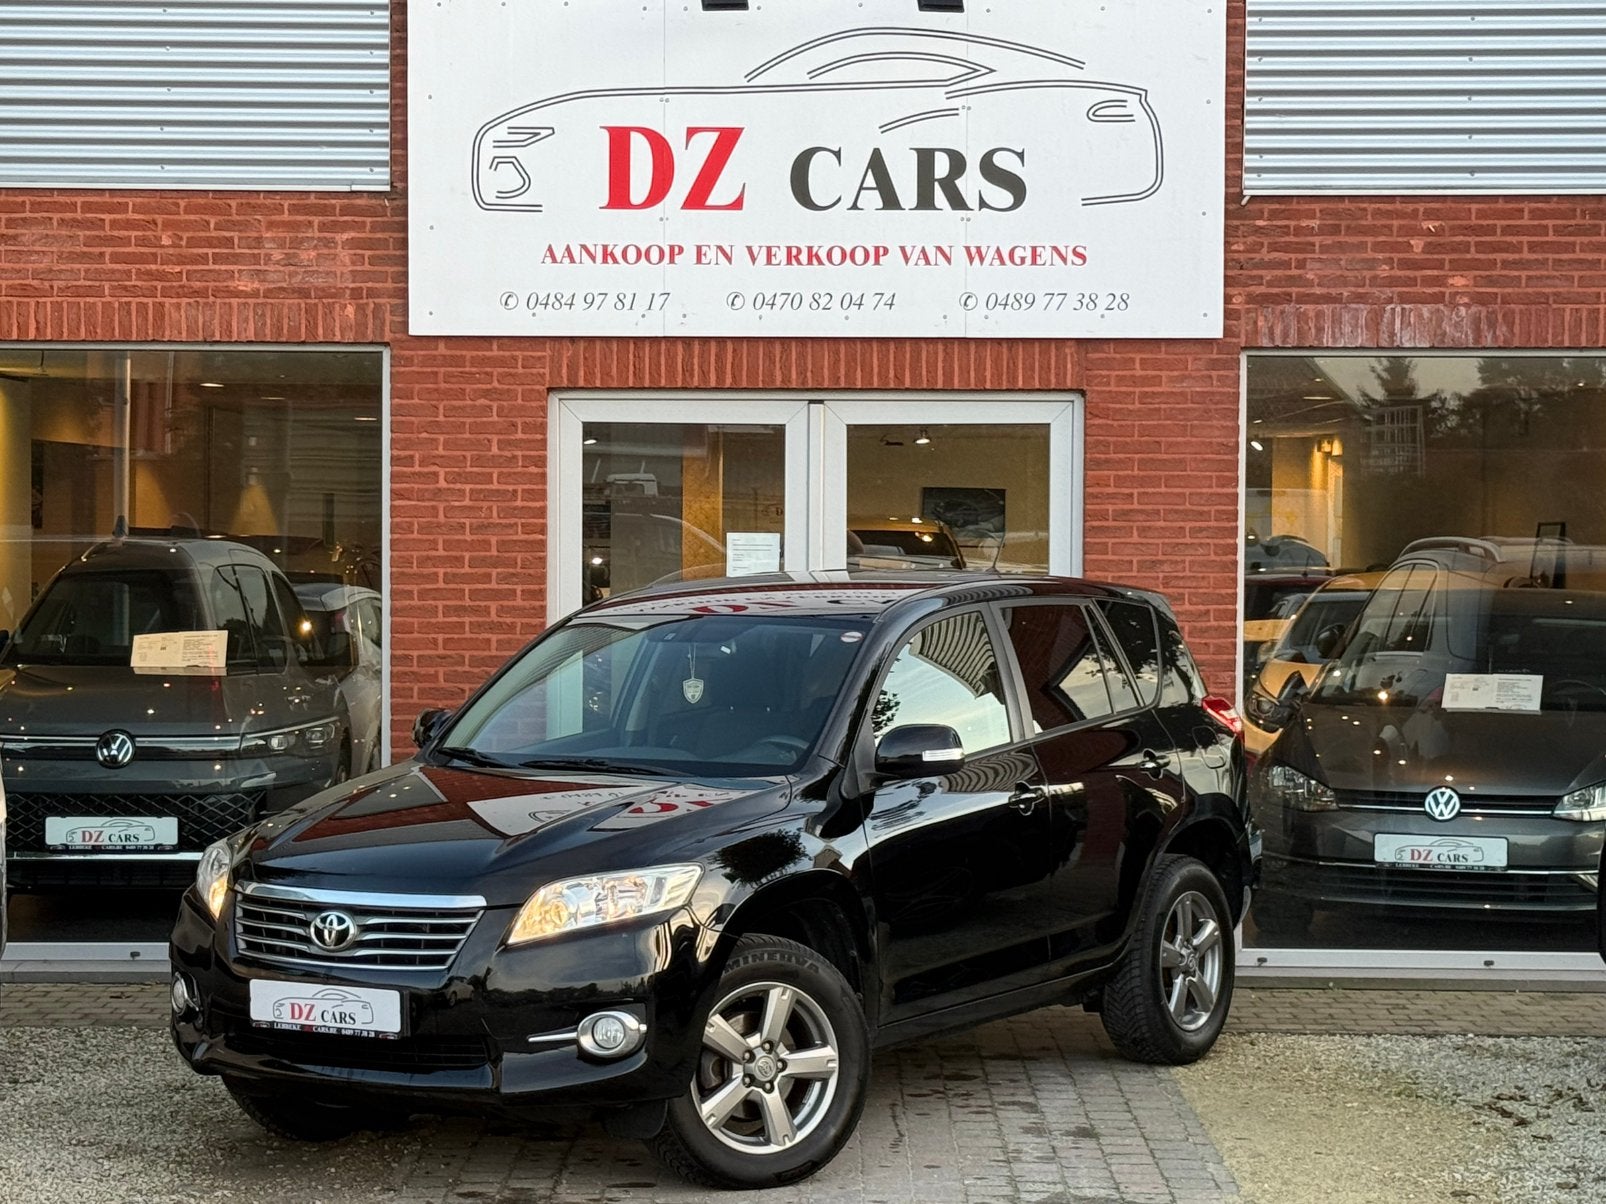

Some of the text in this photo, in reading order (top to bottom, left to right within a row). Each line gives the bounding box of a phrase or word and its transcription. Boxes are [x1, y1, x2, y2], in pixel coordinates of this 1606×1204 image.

[598, 126, 1027, 212] DZ CARS
[541, 244, 1088, 267] AANKOOP EN VERKOOP VAN WAGENS
[526, 292, 671, 311] 0484 97 81 17
[753, 292, 896, 311] 0470 82 04 74
[985, 292, 1130, 311] 0489 77 38 28
[81, 830, 140, 843] DZ CARS
[1410, 848, 1469, 863] DZ CARS
[289, 1002, 356, 1025] DZ CARS
